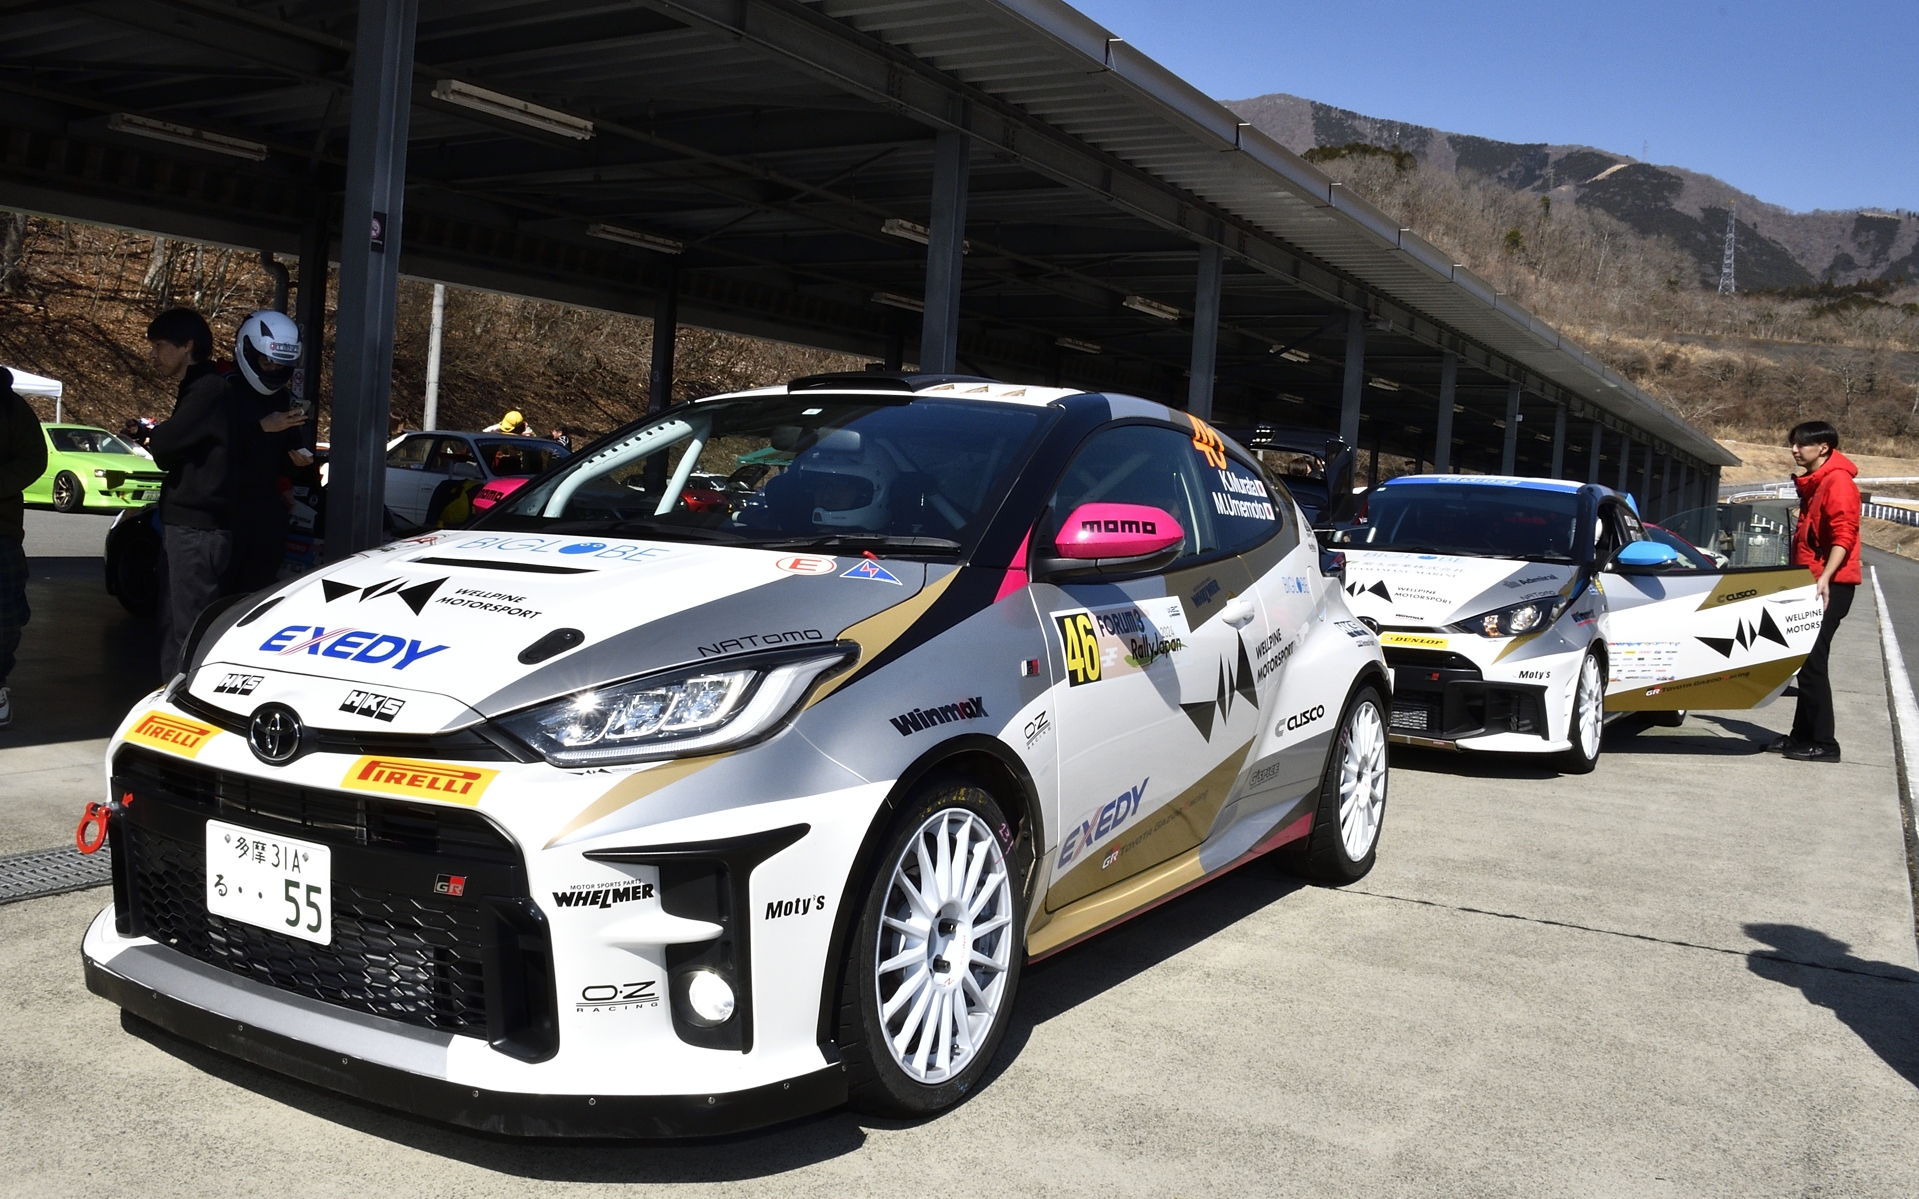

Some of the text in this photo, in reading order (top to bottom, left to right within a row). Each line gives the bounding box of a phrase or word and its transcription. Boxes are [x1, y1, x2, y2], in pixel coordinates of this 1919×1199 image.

[1218, 470, 1258, 496] K.Murata
[1212, 492, 1266, 520] M.Umemoto
[454, 588, 527, 603] WELLPINE
[1394, 592, 1452, 605] MOTORSPORT
[1397, 587, 1437, 595] WELLPINE
[1726, 588, 1757, 602] CUSCO
[436, 596, 543, 620] MOTORSPORT
[1785, 608, 1823, 623] WELLPINE
[1159, 626, 1175, 638] 2024
[1786, 620, 1823, 635] MOTORS
[258, 625, 451, 670] EXEDY
[1064, 615, 1100, 683] 46
[1255, 628, 1282, 660] WELLPINE
[1395, 637, 1443, 645] DUNLOP
[1257, 641, 1295, 683] MOTORSPORT
[213, 673, 265, 696] HKS
[1519, 670, 1551, 680] Moty's
[338, 689, 406, 722] HKS
[1287, 704, 1325, 731] CUSCO
[134, 714, 211, 749] PIRELLI
[356, 760, 482, 795] PIRELLI
[1057, 776, 1150, 869] EXEDY
[552, 883, 654, 909] WHELMER
[570, 878, 642, 891] MOTOR SPORTS PARTS
[765, 895, 825, 920] Moty's
[576, 1002, 659, 1013] RACING
